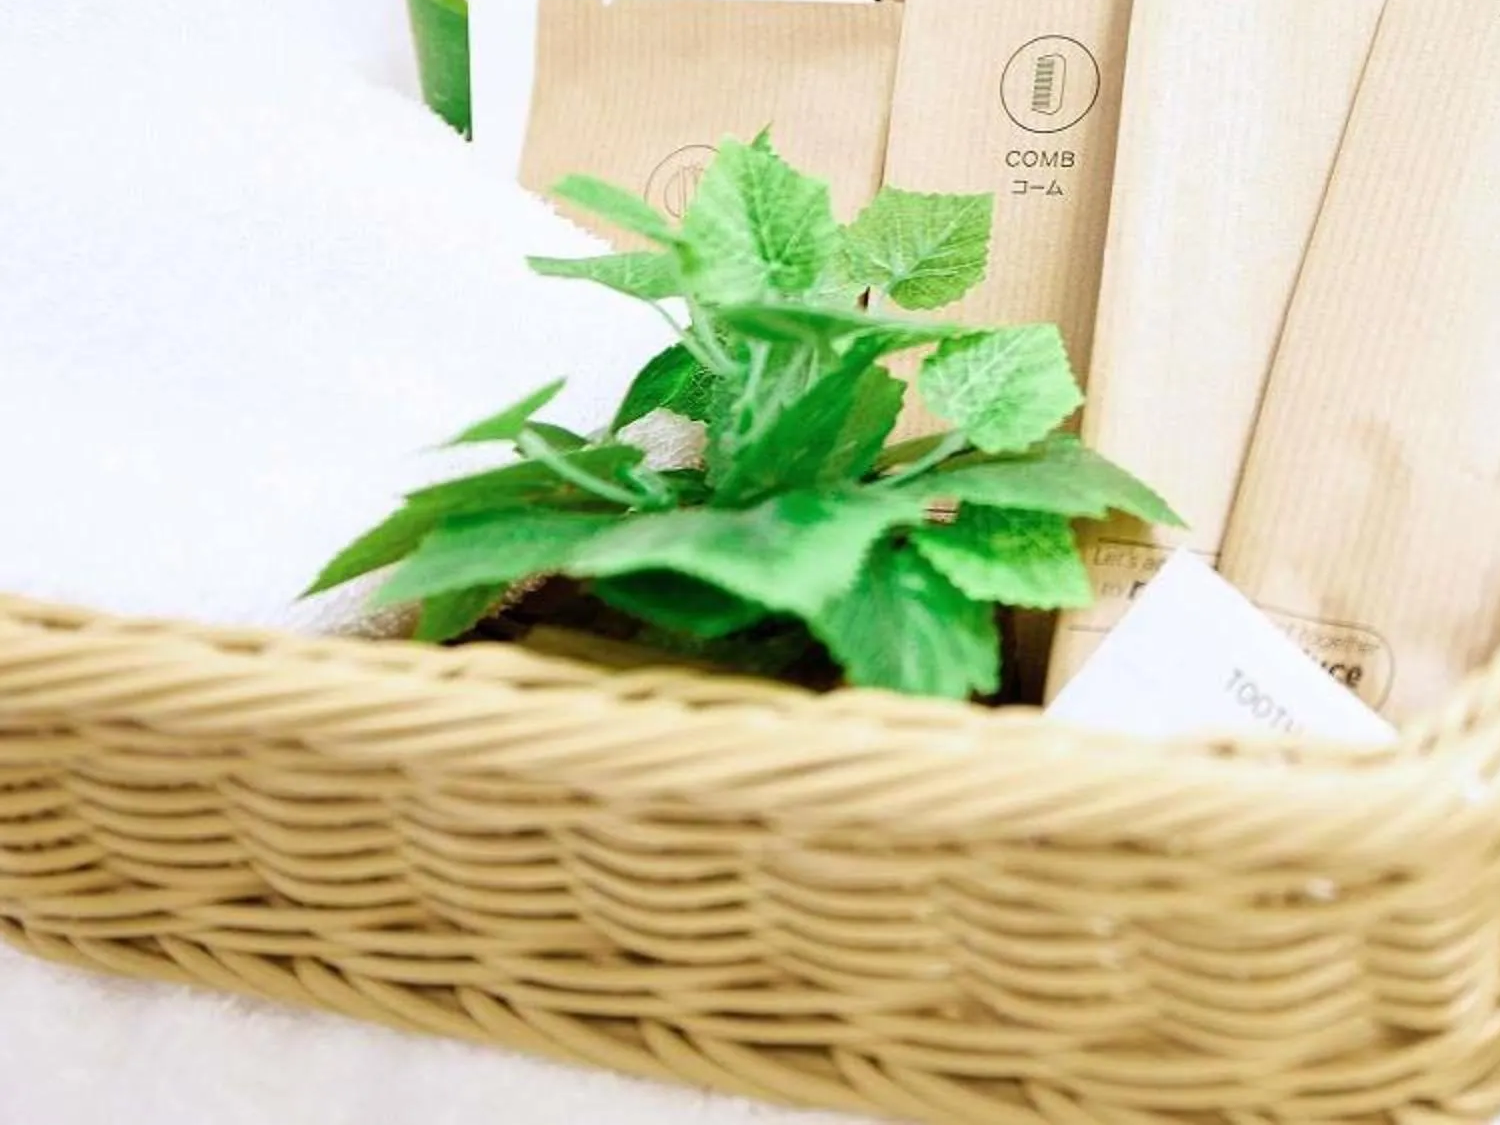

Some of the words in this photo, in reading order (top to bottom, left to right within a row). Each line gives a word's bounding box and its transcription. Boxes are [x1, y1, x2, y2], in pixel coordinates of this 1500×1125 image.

[1005, 150, 1076, 168] COMB
[1010, 179, 1064, 196] コーム
